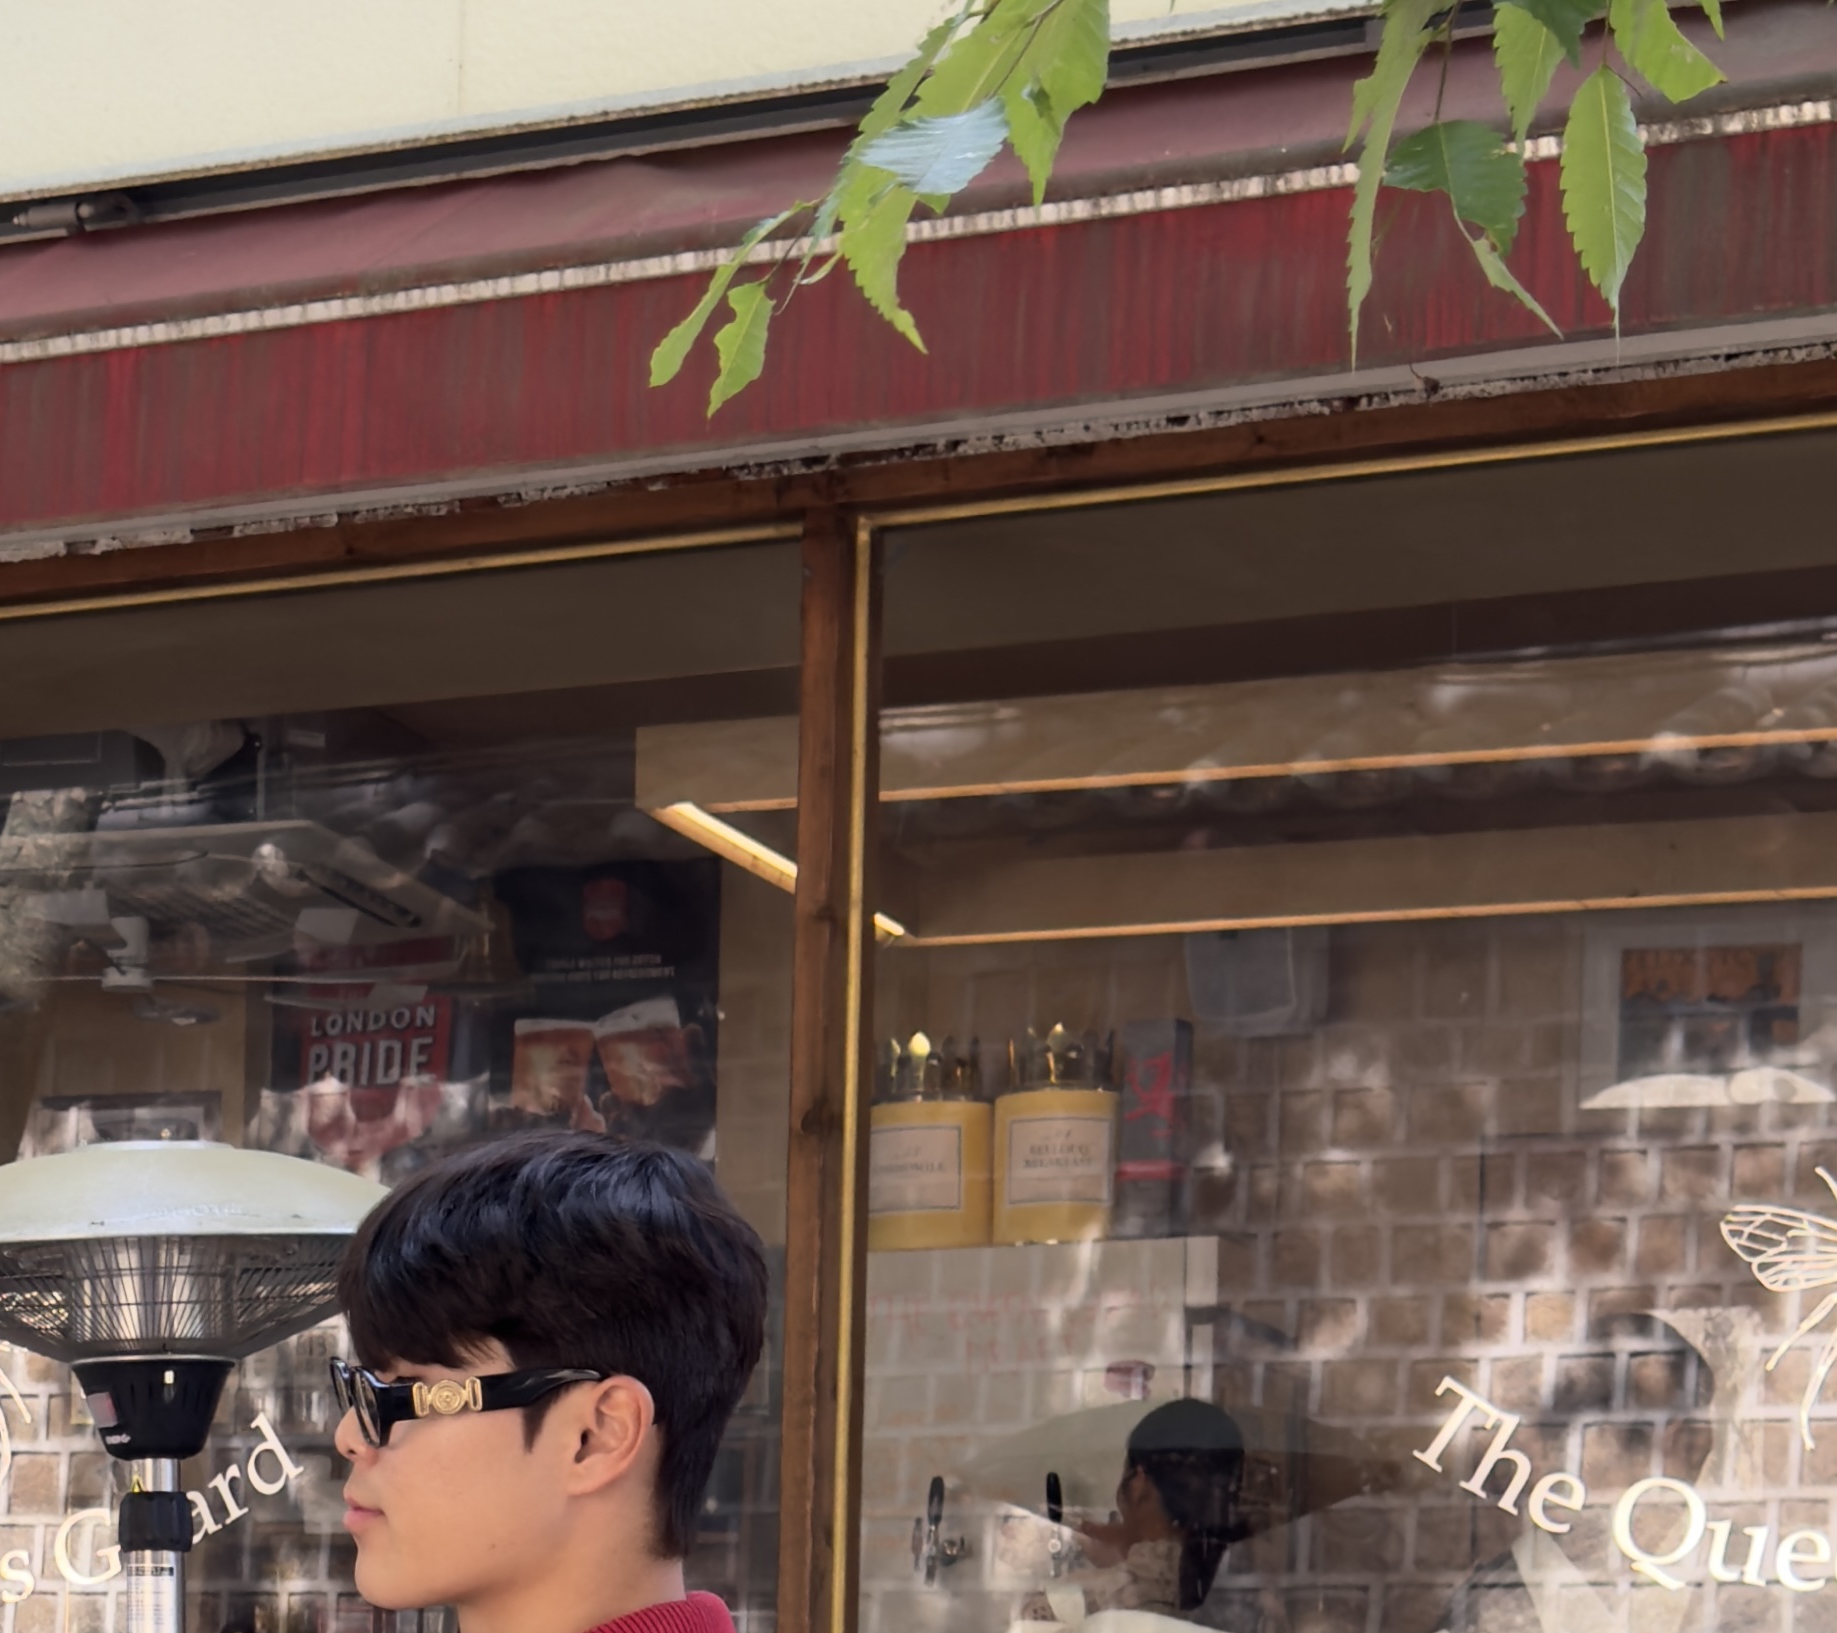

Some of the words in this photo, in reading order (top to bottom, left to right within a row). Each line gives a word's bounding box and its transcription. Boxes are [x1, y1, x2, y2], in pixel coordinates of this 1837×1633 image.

[307, 1036, 434, 1087] PRIDE
[310, 1004, 436, 1038] LONDON
[54, 1411, 305, 1586] Gard
[1412, 1375, 1587, 1534] The
[1612, 1476, 1837, 1592] Que
